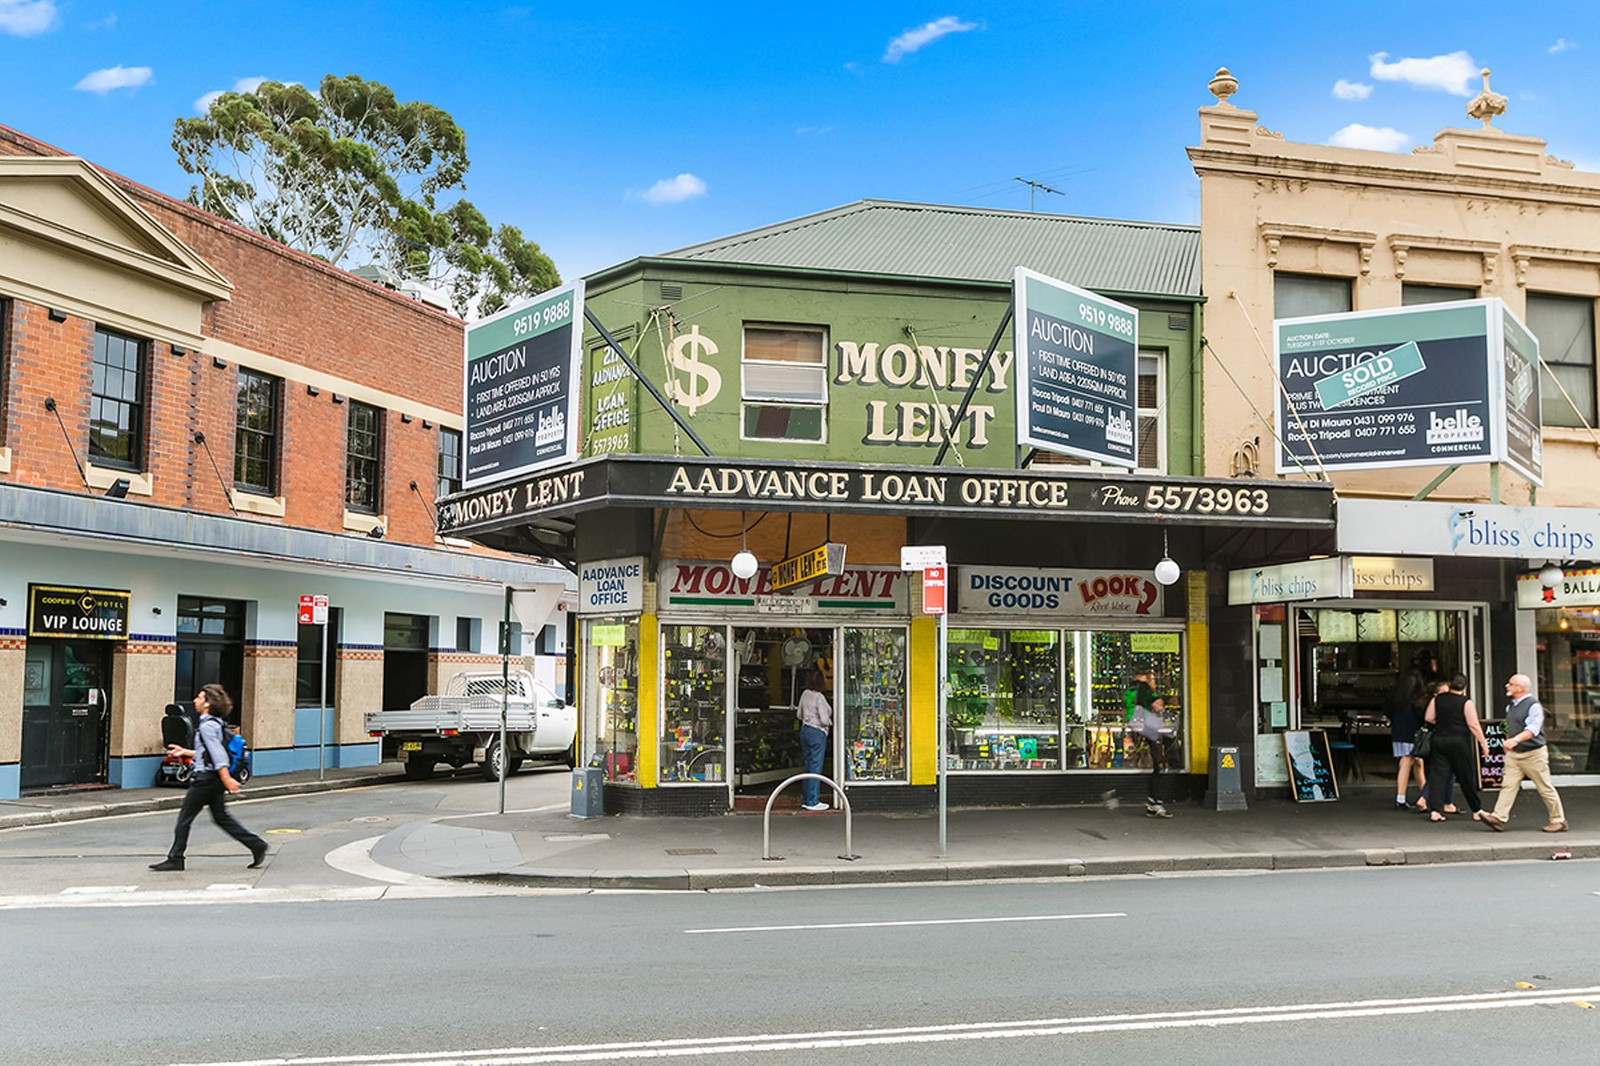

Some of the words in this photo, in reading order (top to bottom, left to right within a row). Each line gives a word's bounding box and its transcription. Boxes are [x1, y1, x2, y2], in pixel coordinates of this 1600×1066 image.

[513, 309, 540, 337] 9519
[543, 299, 570, 326] 9888
[1079, 303, 1105, 327] 9519
[1108, 311, 1133, 337] 9888
[1031, 317, 1094, 355] AUCTION
[470, 346, 527, 387] AUCTION
[664, 323, 722, 418] $
[834, 341, 1014, 393] MONEY
[1039, 365, 1058, 380] LAND
[1071, 360, 1100, 378] OFFERED
[1286, 350, 1384, 379] AUCTIO
[1342, 357, 1393, 388] SOLD
[504, 376, 531, 395] OFFERED
[476, 404, 493, 419] LAND
[596, 392, 625, 414] LOAN
[1308, 400, 1321, 410] TW
[538, 405, 564, 431] belle
[593, 408, 630, 432] OFFICE
[863, 400, 996, 447] LENT
[1107, 406, 1132, 432] belle
[1287, 421, 1308, 430] Paul
[1322, 418, 1352, 428] Mauro
[1353, 415, 1375, 426] 0431
[1378, 414, 1395, 424] 099
[1397, 413, 1415, 423] 976
[1430, 408, 1481, 431] belle
[592, 433, 629, 455] 5573963
[1287, 431, 1318, 441] Rocco
[1320, 429, 1351, 441] Tripodi
[1355, 427, 1377, 438] 0407
[1380, 426, 1396, 435] 771
[1398, 425, 1416, 434] 655
[1431, 431, 1480, 440] PROPERTY
[1431, 443, 1482, 453] COMMERCIAL
[454, 487, 518, 525] MONEY
[525, 471, 585, 509] LENT
[665, 466, 850, 500] AADVANCE
[860, 473, 948, 503] LOAN
[961, 478, 1069, 507] OFFICE
[1100, 485, 1140, 507] Phone
[1146, 485, 1270, 515] 5573963
[1469, 519, 1520, 546] bliss
[1533, 522, 1594, 555] chips
[582, 563, 640, 582] AADVANCE
[670, 565, 793, 596] MONE
[808, 569, 900, 598] LENT
[970, 574, 1073, 592] DISCOUNT
[1353, 568, 1375, 585] liss
[1383, 568, 1423, 589] chips
[596, 579, 625, 592] LOAN
[1079, 575, 1141, 604] LOOK
[1261, 578, 1283, 596] bliss
[1288, 575, 1317, 597] chips
[81, 596, 93, 610] C
[97, 601, 124, 609] HOTEL
[590, 591, 628, 606] OFFICE
[988, 592, 1060, 609] GOODS
[42, 614, 68, 629] VIP
[72, 616, 123, 631] LOUNGE
[1485, 725, 1503, 735] ALL
[1486, 737, 1505, 748] EGAN
[1484, 754, 1505, 763] DUC
